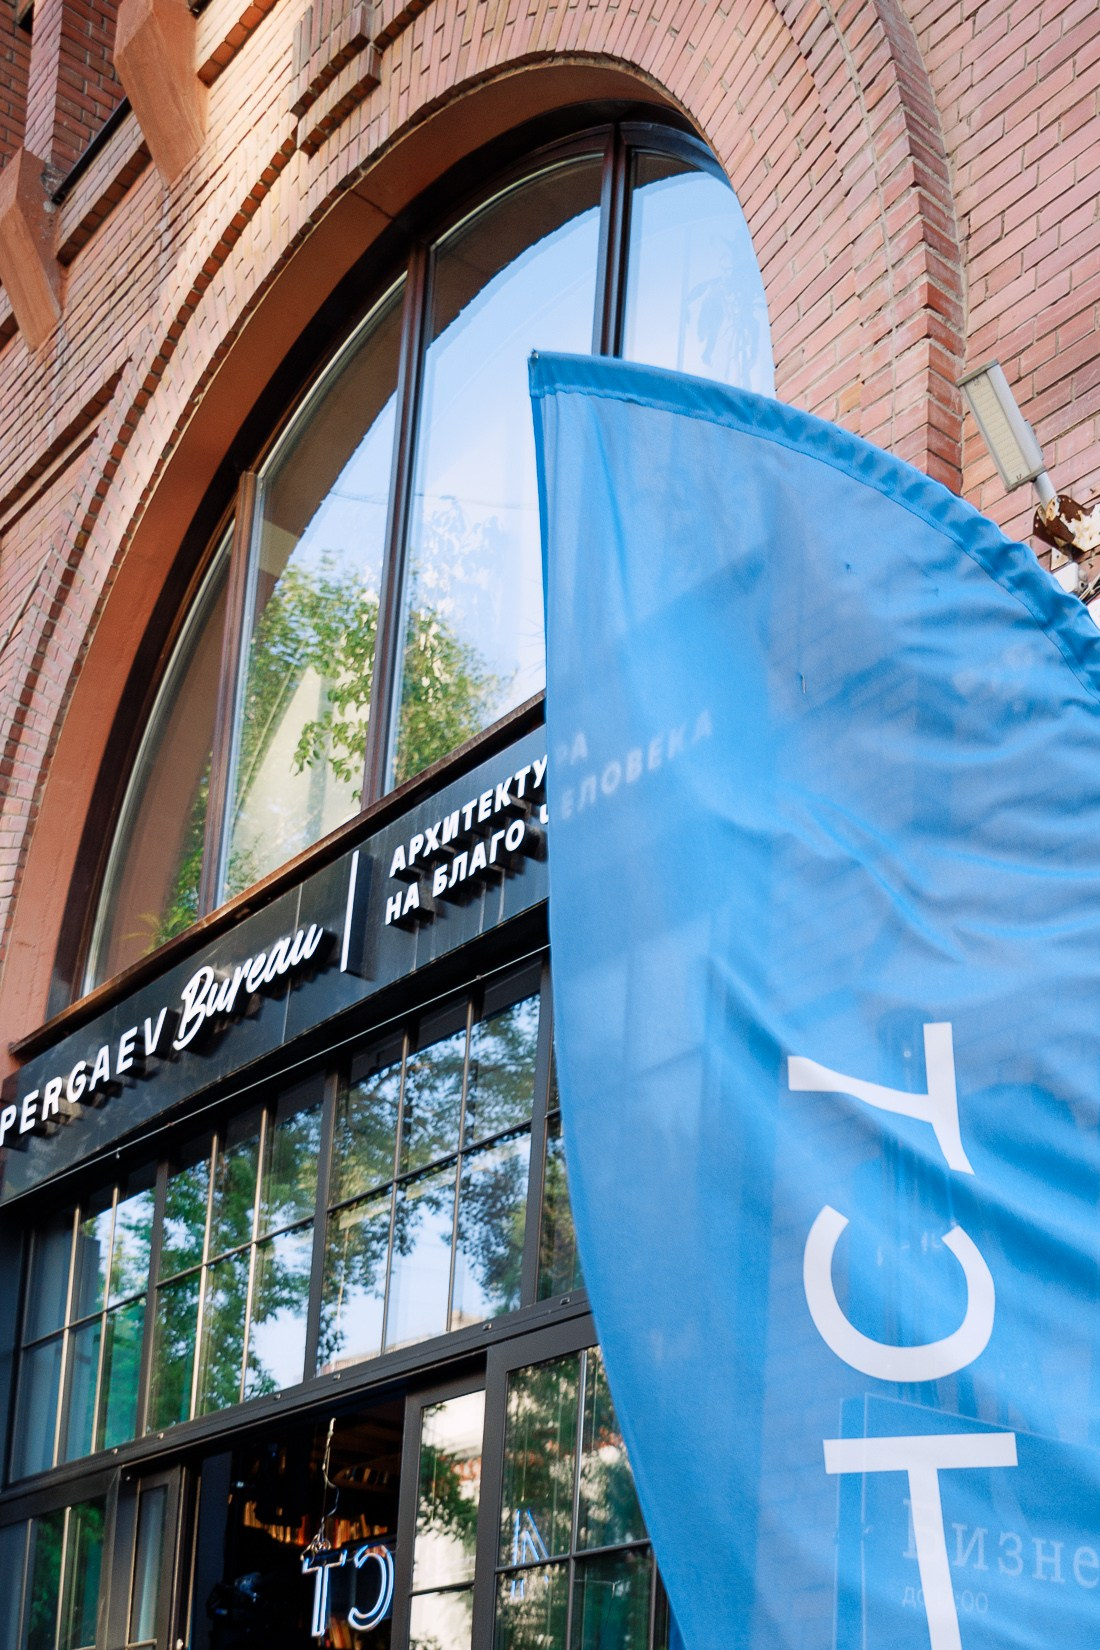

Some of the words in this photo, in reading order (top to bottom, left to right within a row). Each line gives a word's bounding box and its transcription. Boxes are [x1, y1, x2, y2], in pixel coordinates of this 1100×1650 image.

[385, 892, 420, 926] НА
[431, 819, 525, 898] БЛАГО
[0, 1008, 168, 1148] PERGAEV
[174, 923, 323, 1052] Bureau
